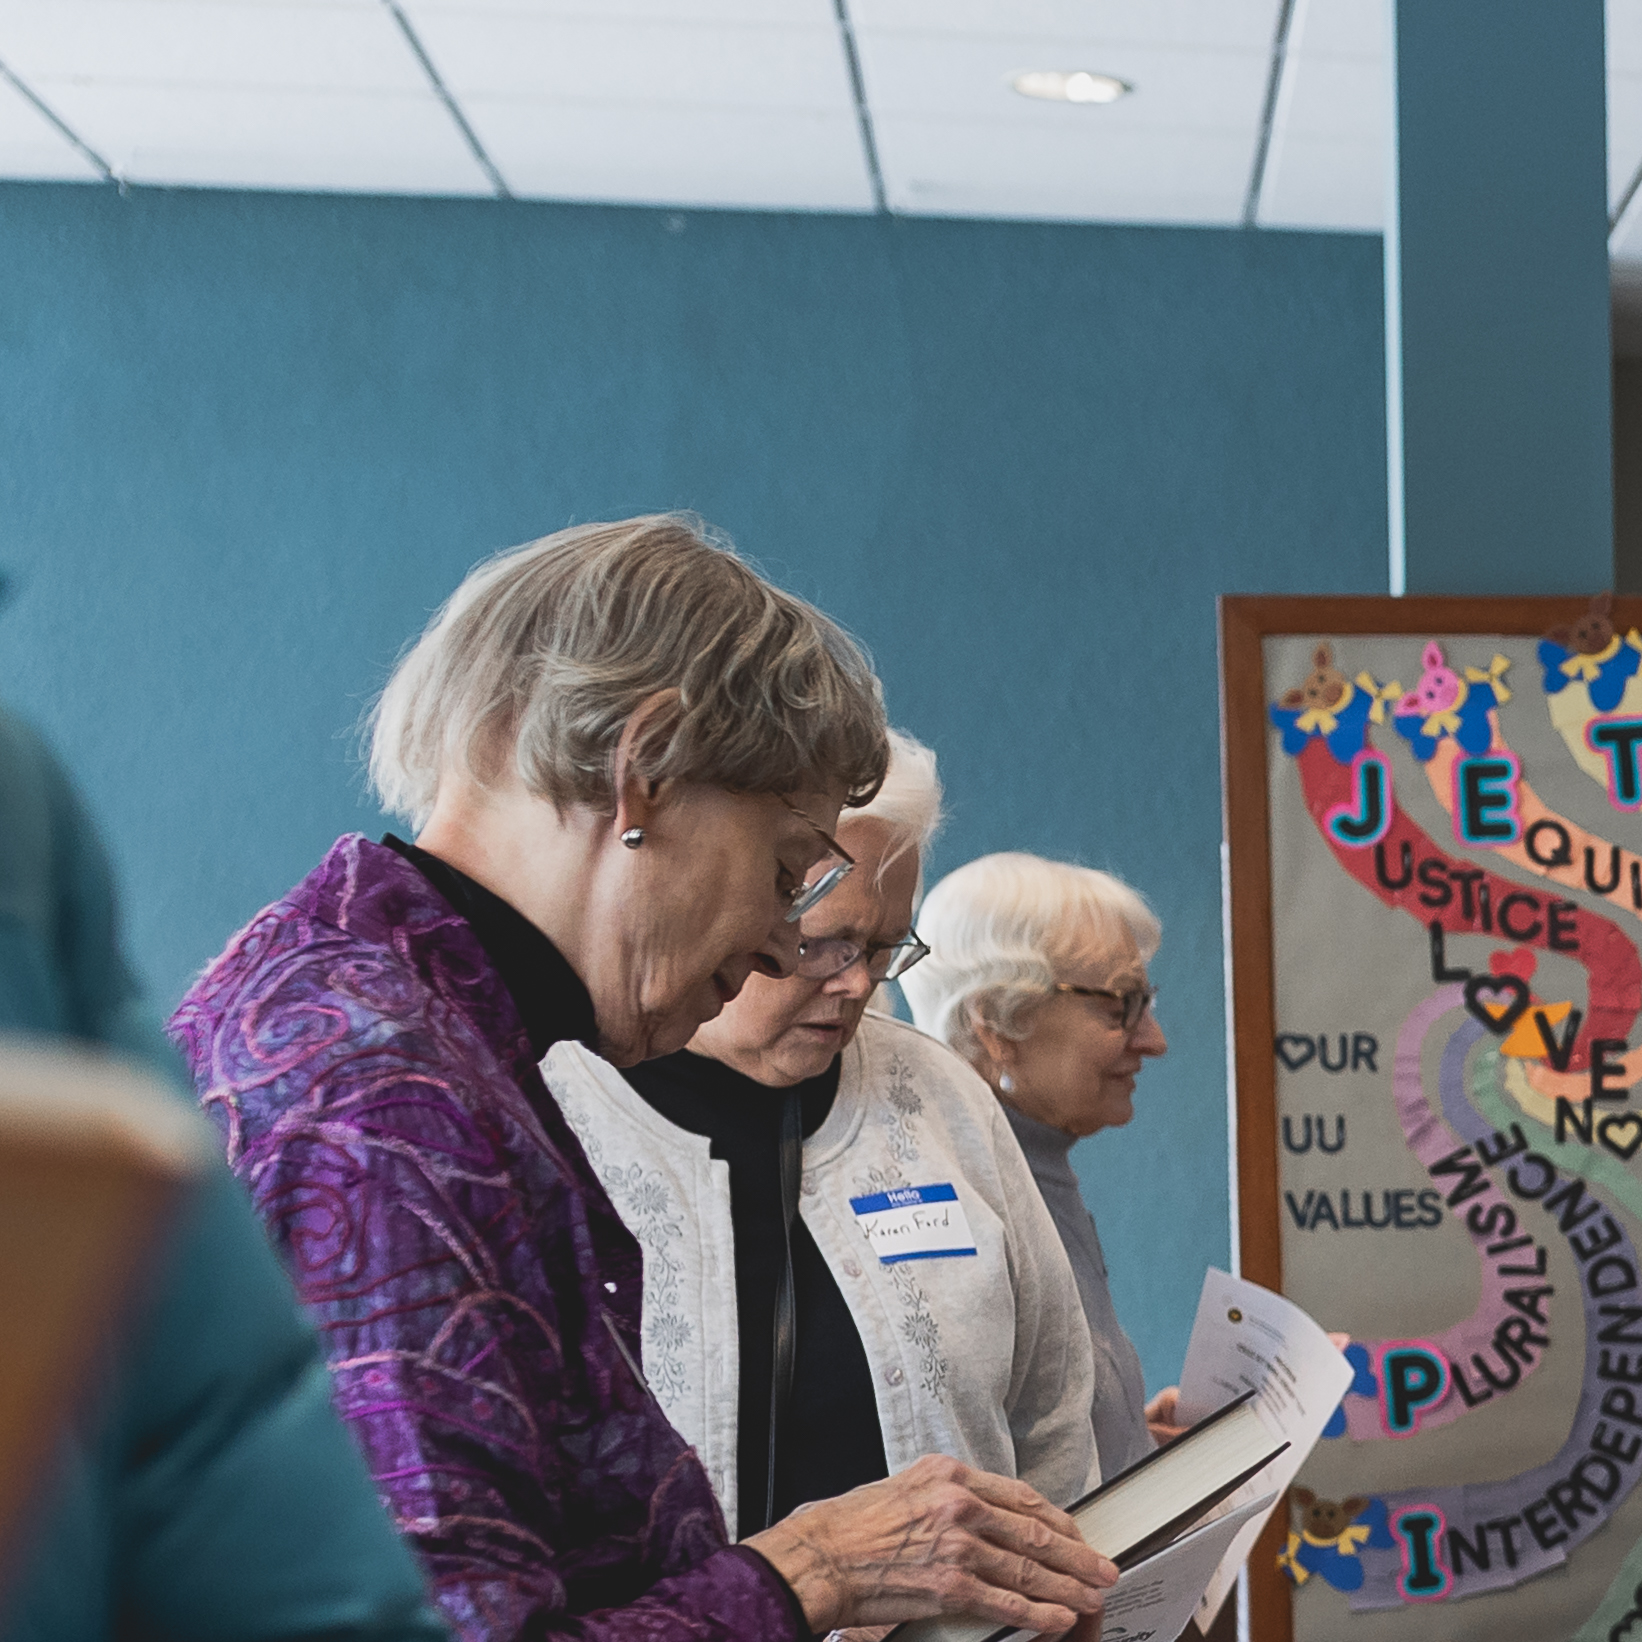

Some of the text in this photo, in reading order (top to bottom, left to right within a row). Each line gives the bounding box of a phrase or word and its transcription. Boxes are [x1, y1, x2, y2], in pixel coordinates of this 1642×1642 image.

[1324, 749, 1581, 953] JUSTICE
[1282, 1114, 1347, 1156] UU
[863, 1208, 950, 1240] Karen Ford
[1283, 1187, 1443, 1231] VALUES
[1376, 1146, 1554, 1439] PLURALISM
